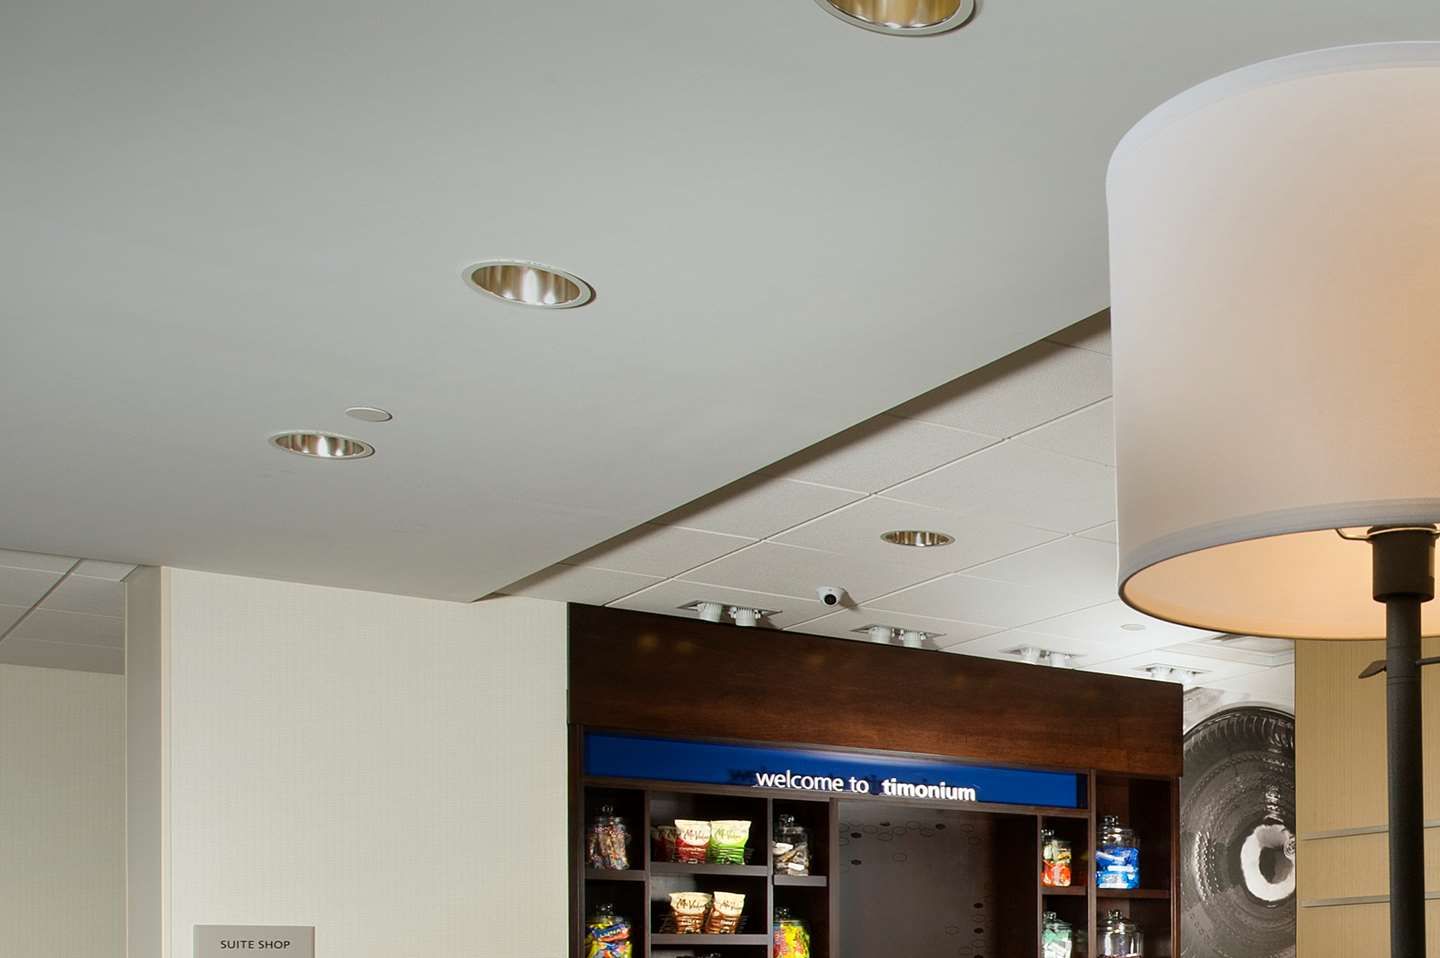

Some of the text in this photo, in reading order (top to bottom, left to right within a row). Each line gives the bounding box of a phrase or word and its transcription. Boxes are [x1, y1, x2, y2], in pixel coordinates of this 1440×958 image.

[756, 770, 976, 801] welcome to timonium
[220, 940, 291, 949] SUITE SHOP
